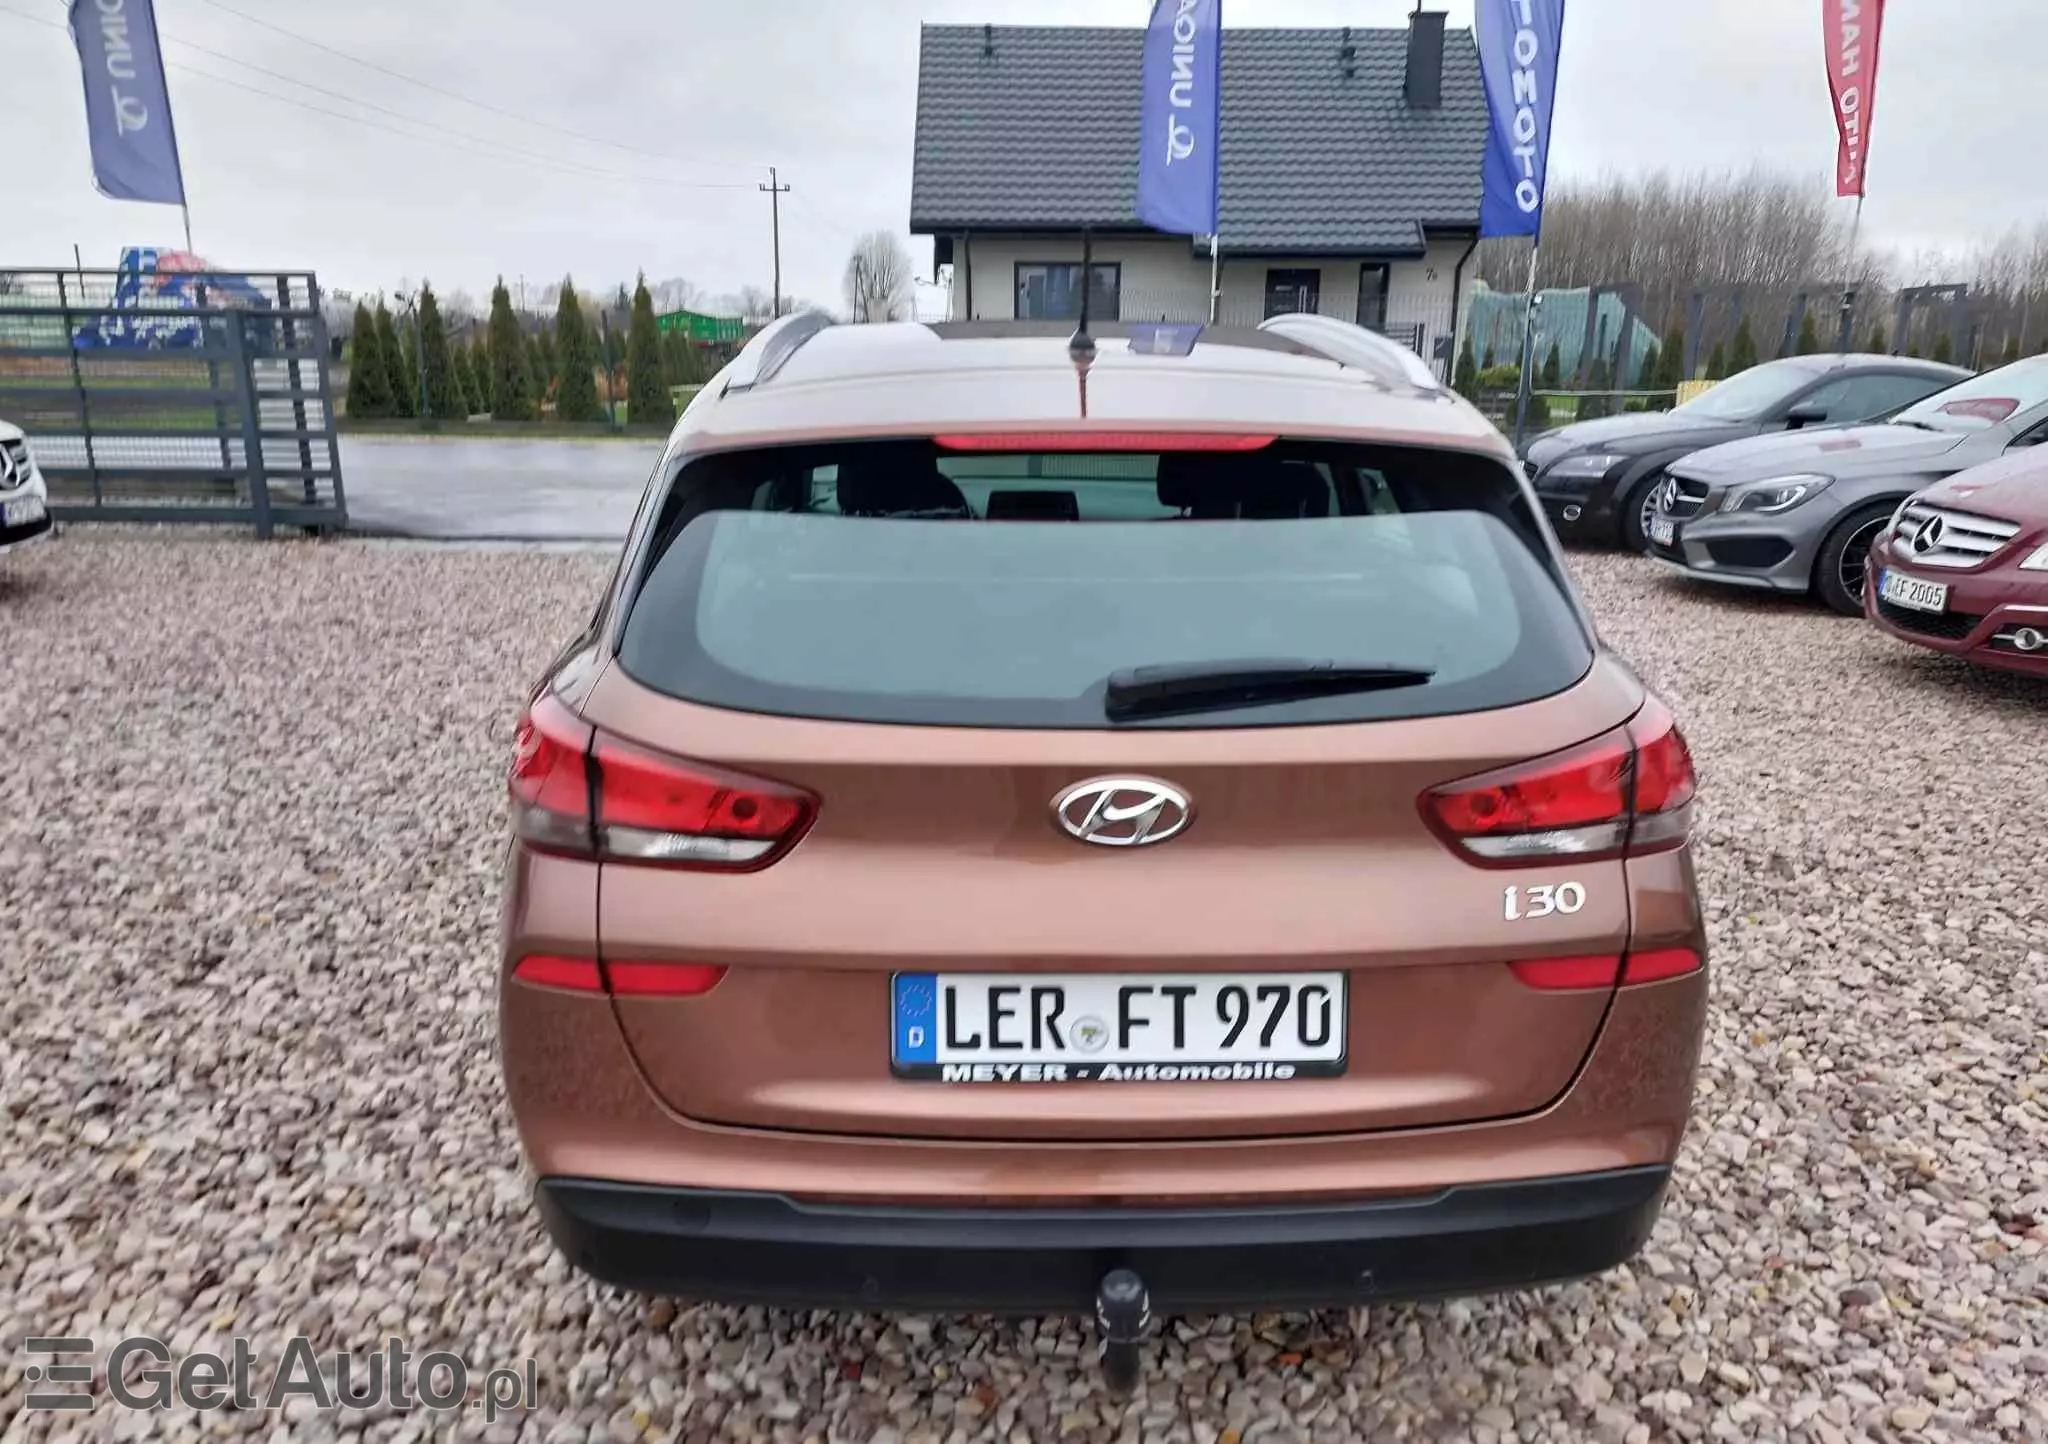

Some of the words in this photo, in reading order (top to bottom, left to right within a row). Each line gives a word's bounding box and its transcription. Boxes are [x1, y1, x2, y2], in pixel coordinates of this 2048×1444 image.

[1909, 582, 1943, 606] 2005
[1504, 881, 1586, 920] i30
[945, 985, 1065, 1049] LER
[1118, 985, 1197, 1049] FT
[1216, 985, 1331, 1049] 970
[942, 1063, 1067, 1082] MEYER
[1098, 1062, 1296, 1081] Automobile
